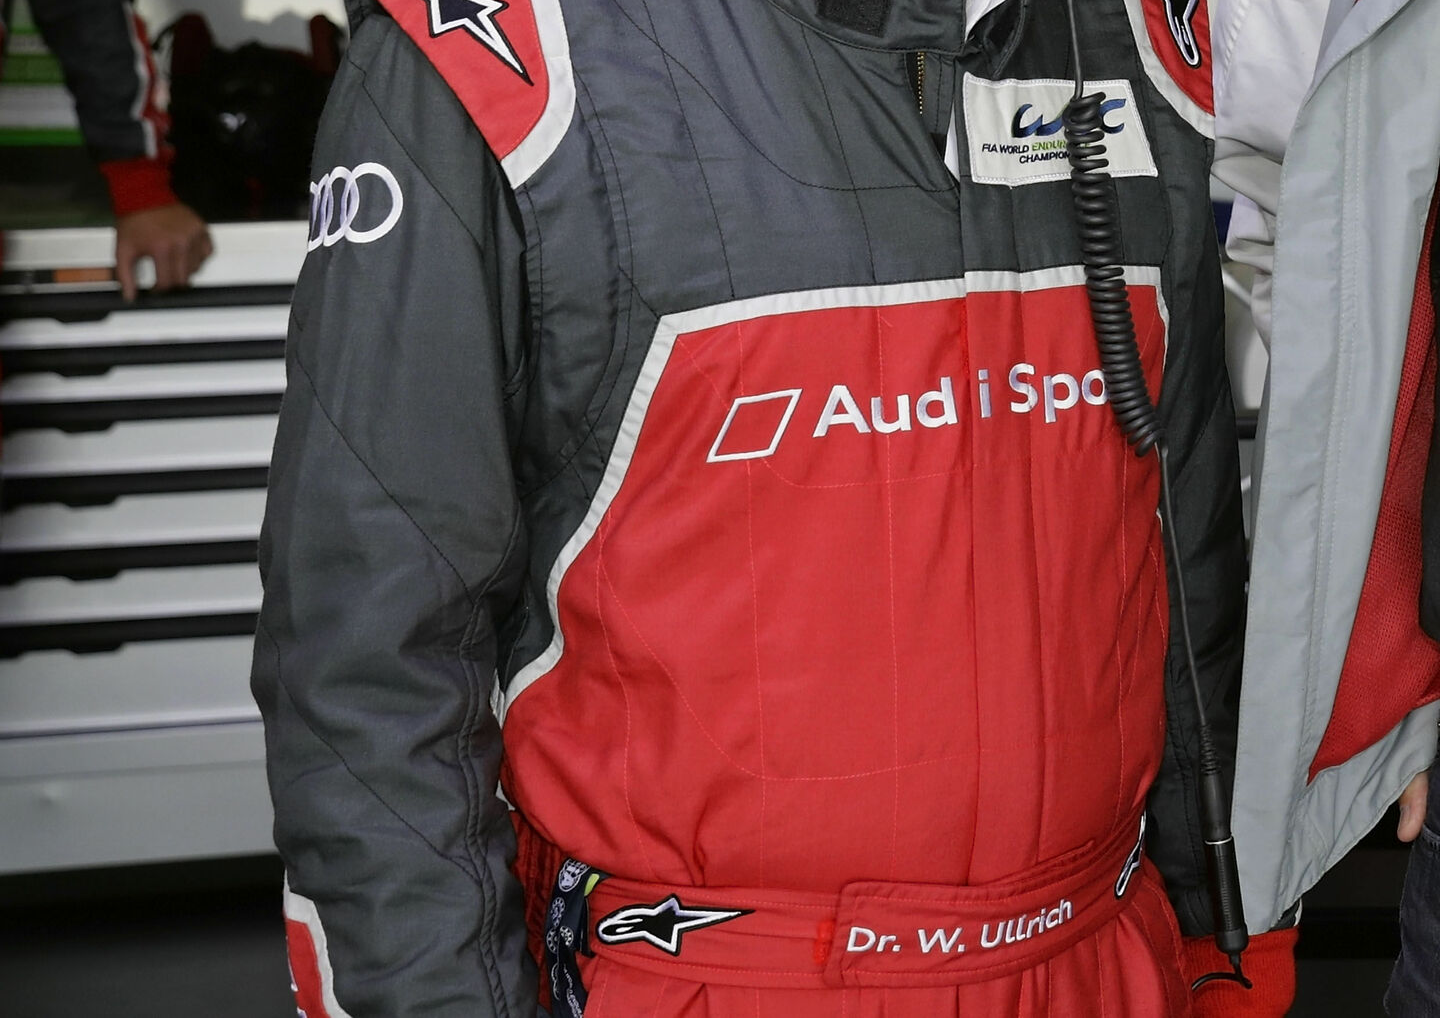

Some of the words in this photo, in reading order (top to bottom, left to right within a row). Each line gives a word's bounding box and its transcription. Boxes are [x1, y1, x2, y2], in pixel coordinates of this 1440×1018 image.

[982, 143, 998, 153] FIA
[1000, 144, 1029, 154] WORLD
[812, 368, 992, 438] Audi
[1008, 362, 1109, 424] Spo
[846, 926, 901, 952] Dr.
[917, 927, 966, 953] W.
[980, 898, 1073, 949] Ullrich
